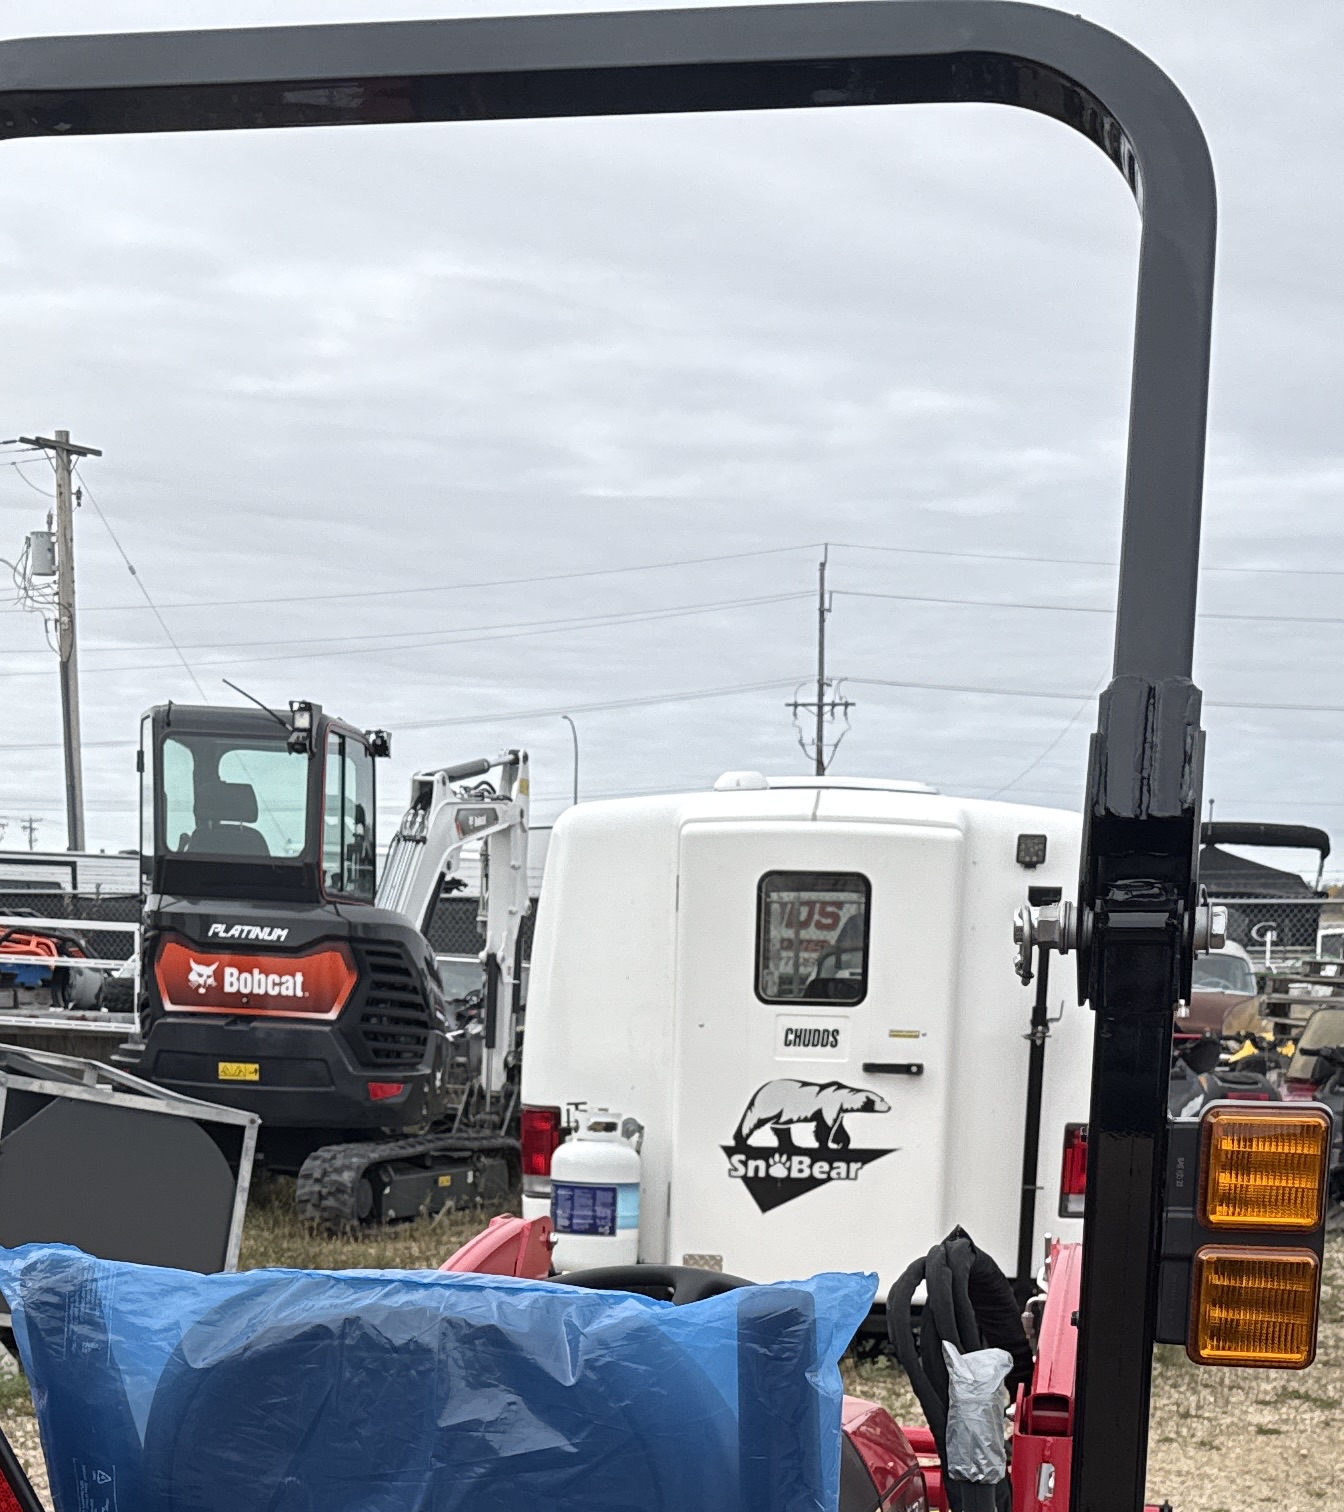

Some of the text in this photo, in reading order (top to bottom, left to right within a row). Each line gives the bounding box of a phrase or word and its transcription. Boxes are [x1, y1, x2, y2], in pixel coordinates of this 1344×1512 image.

[208, 924, 289, 941] PLATINUM
[223, 966, 304, 998] Bobcat
[784, 1027, 840, 1049] CHUDDS
